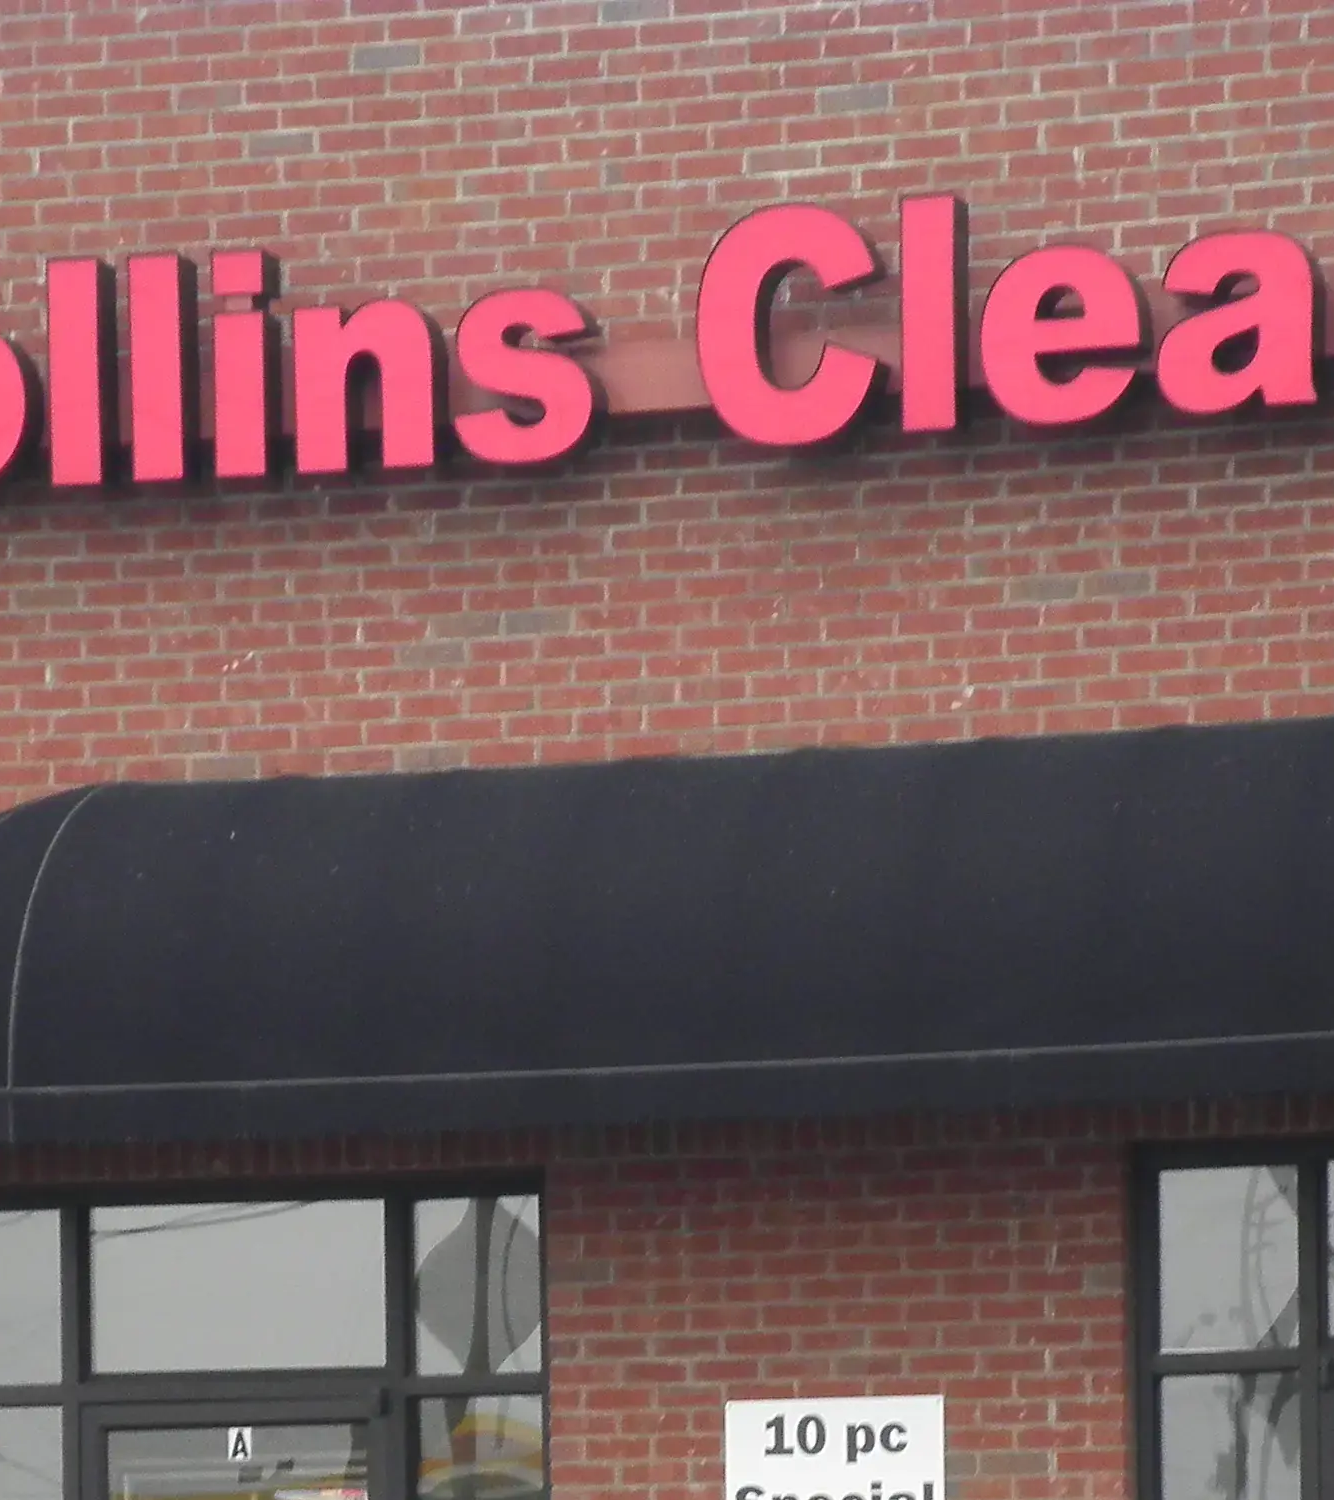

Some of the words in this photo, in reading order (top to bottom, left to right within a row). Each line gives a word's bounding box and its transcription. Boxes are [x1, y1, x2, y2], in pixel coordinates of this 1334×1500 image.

[231, 1431, 248, 1459] A
[764, 1413, 827, 1458] 10
[845, 1419, 908, 1465] pc
